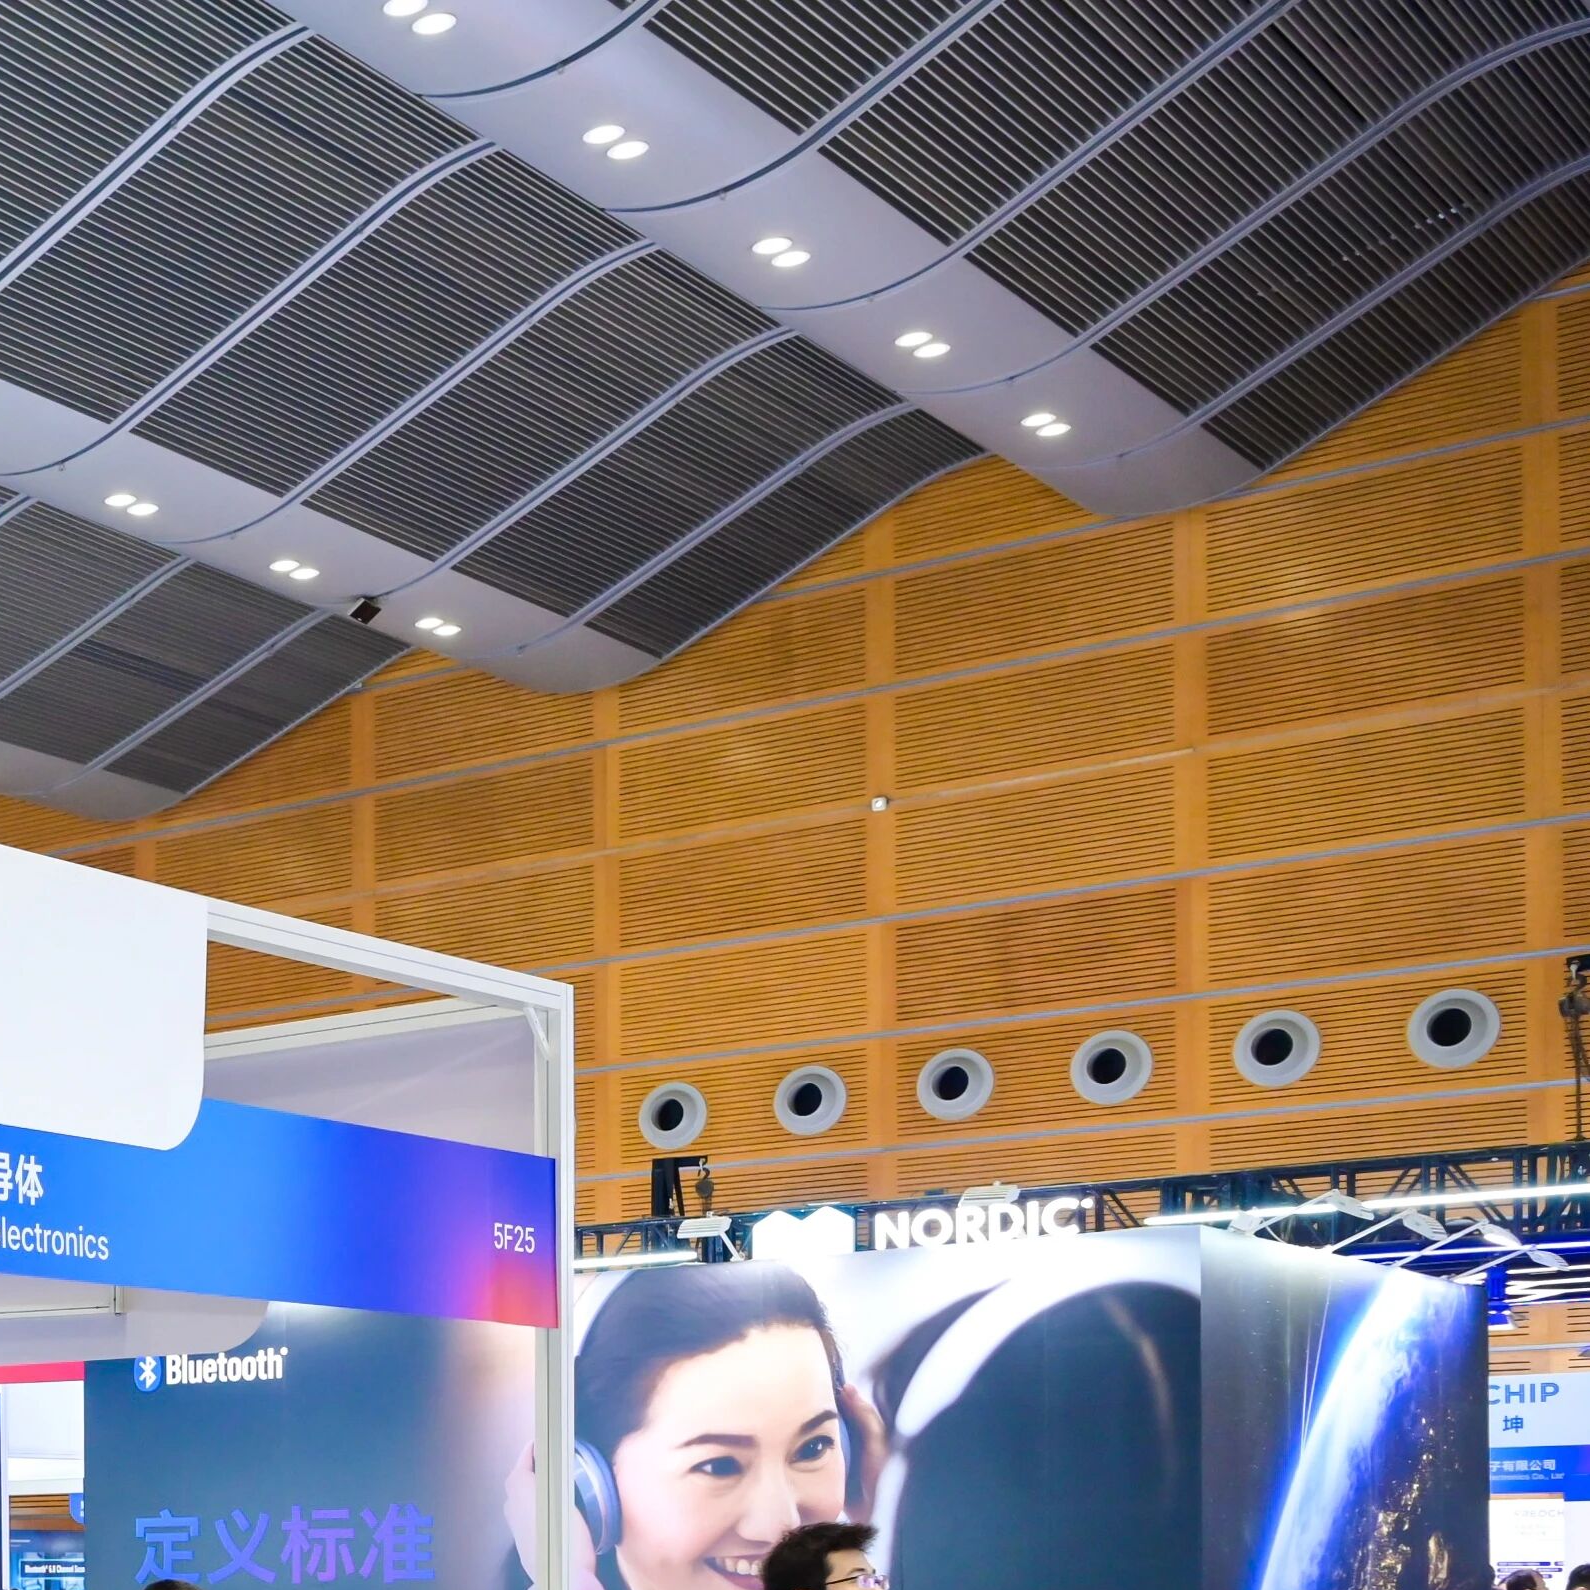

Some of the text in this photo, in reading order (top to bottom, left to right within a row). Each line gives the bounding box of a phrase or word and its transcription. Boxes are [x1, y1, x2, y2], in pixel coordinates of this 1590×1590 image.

[493, 1222, 536, 1254] 5F25
[874, 1197, 1082, 1251] NORDIC
[134, 1504, 436, 1586] 定义标准
